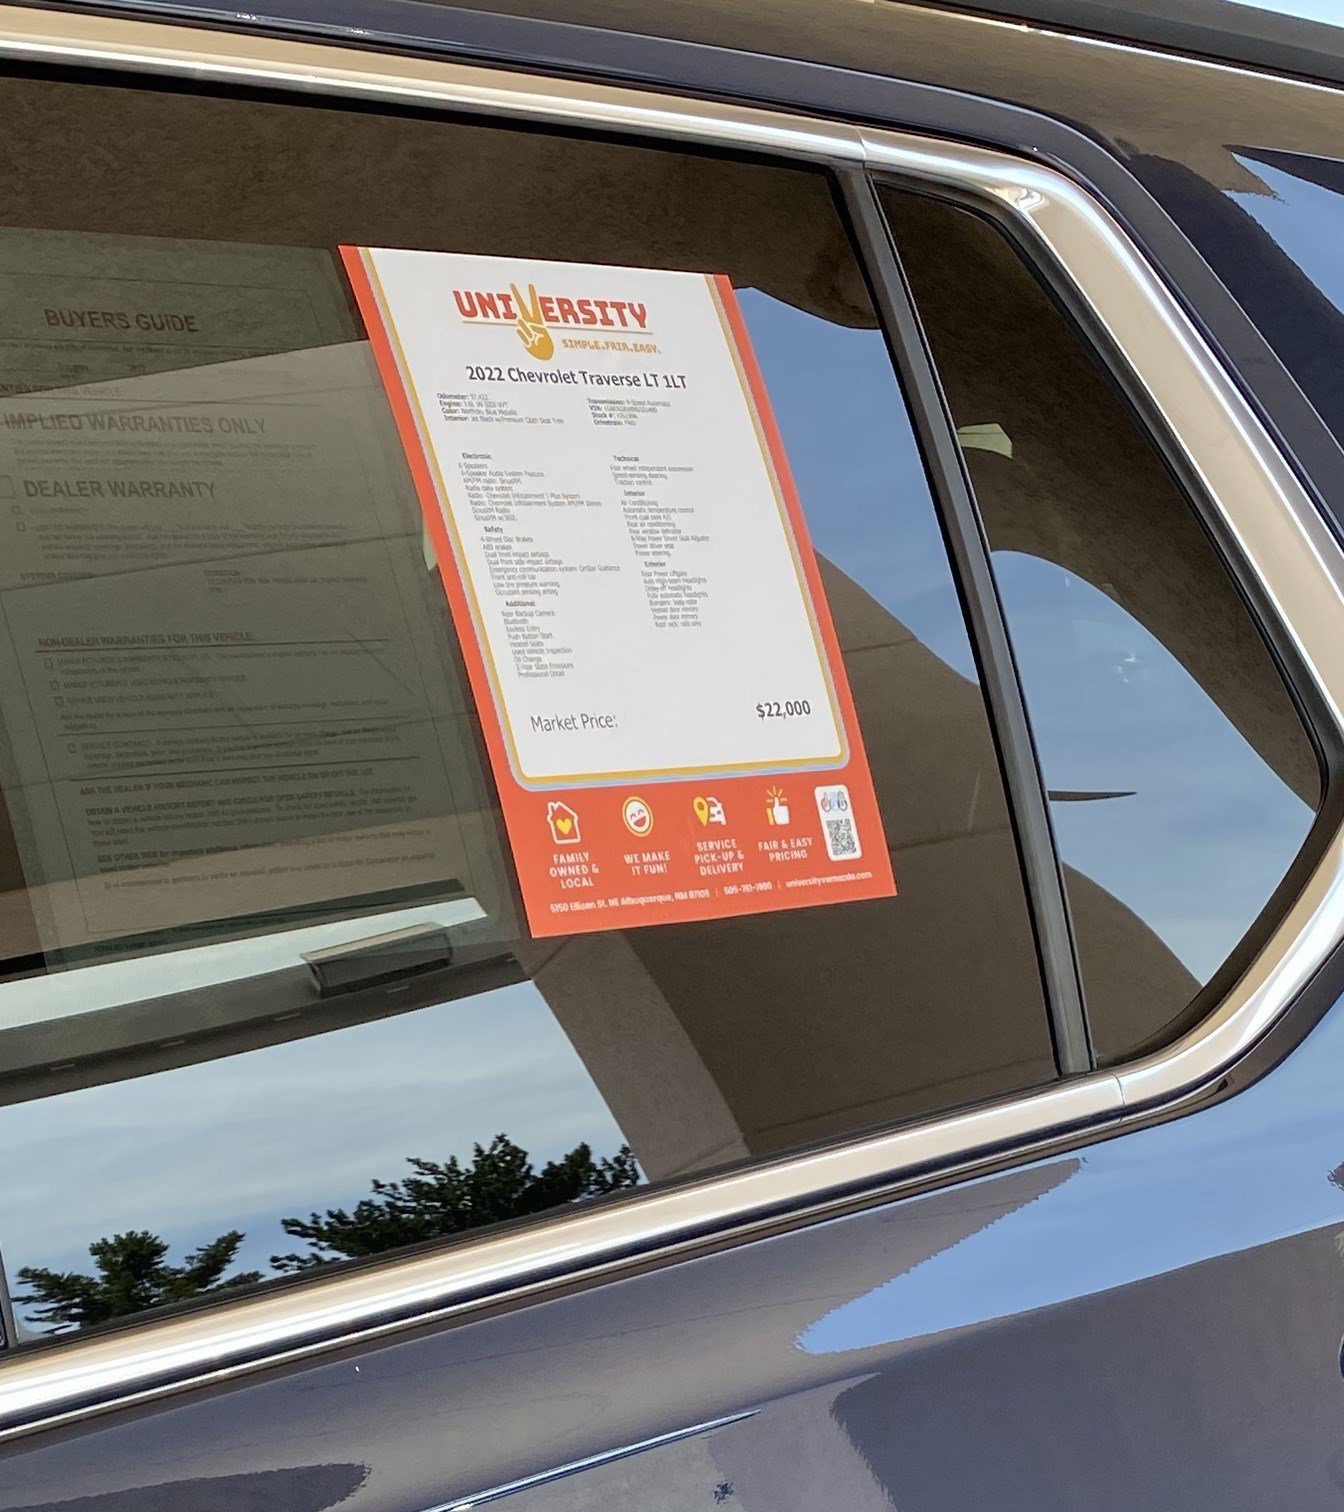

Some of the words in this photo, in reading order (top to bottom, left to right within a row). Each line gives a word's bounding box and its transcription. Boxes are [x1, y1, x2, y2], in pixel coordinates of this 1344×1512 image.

[452, 284, 648, 328] UNIVERSITY
[44, 308, 130, 331] BUYERS
[135, 312, 201, 333] GUIDE
[466, 366, 505, 382] 2022
[508, 367, 577, 385] Chevrolet
[579, 371, 641, 387] Traverse
[643, 374, 659, 388] LT
[662, 375, 687, 389] 1LT
[3, 412, 84, 431] IMPLIED
[87, 414, 213, 434] WARRANTIES
[217, 417, 266, 434] ONLY
[24, 480, 104, 498] DEALER
[108, 479, 216, 499] WARRANTY
[530, 713, 578, 732] Market
[581, 712, 618, 730] Price:
[756, 700, 812, 720] $22,000
[696, 838, 738, 851] SERVICE
[757, 840, 779, 851] FAIR
[780, 839, 788, 848] &
[789, 836, 814, 848] EASY
[552, 851, 591, 864] FAMILY
[623, 853, 640, 864] WE
[640, 850, 671, 862] MAKE
[693, 851, 735, 864] PICK-UP
[736, 850, 745, 859] &
[768, 849, 808, 861] PRICING
[548, 864, 589, 877] OWNED
[590, 863, 599, 873] &
[630, 866, 642, 875] IT
[642, 863, 668, 874] FUN!
[698, 862, 745, 876] DELIVERY
[559, 876, 594, 888] LOCAL
